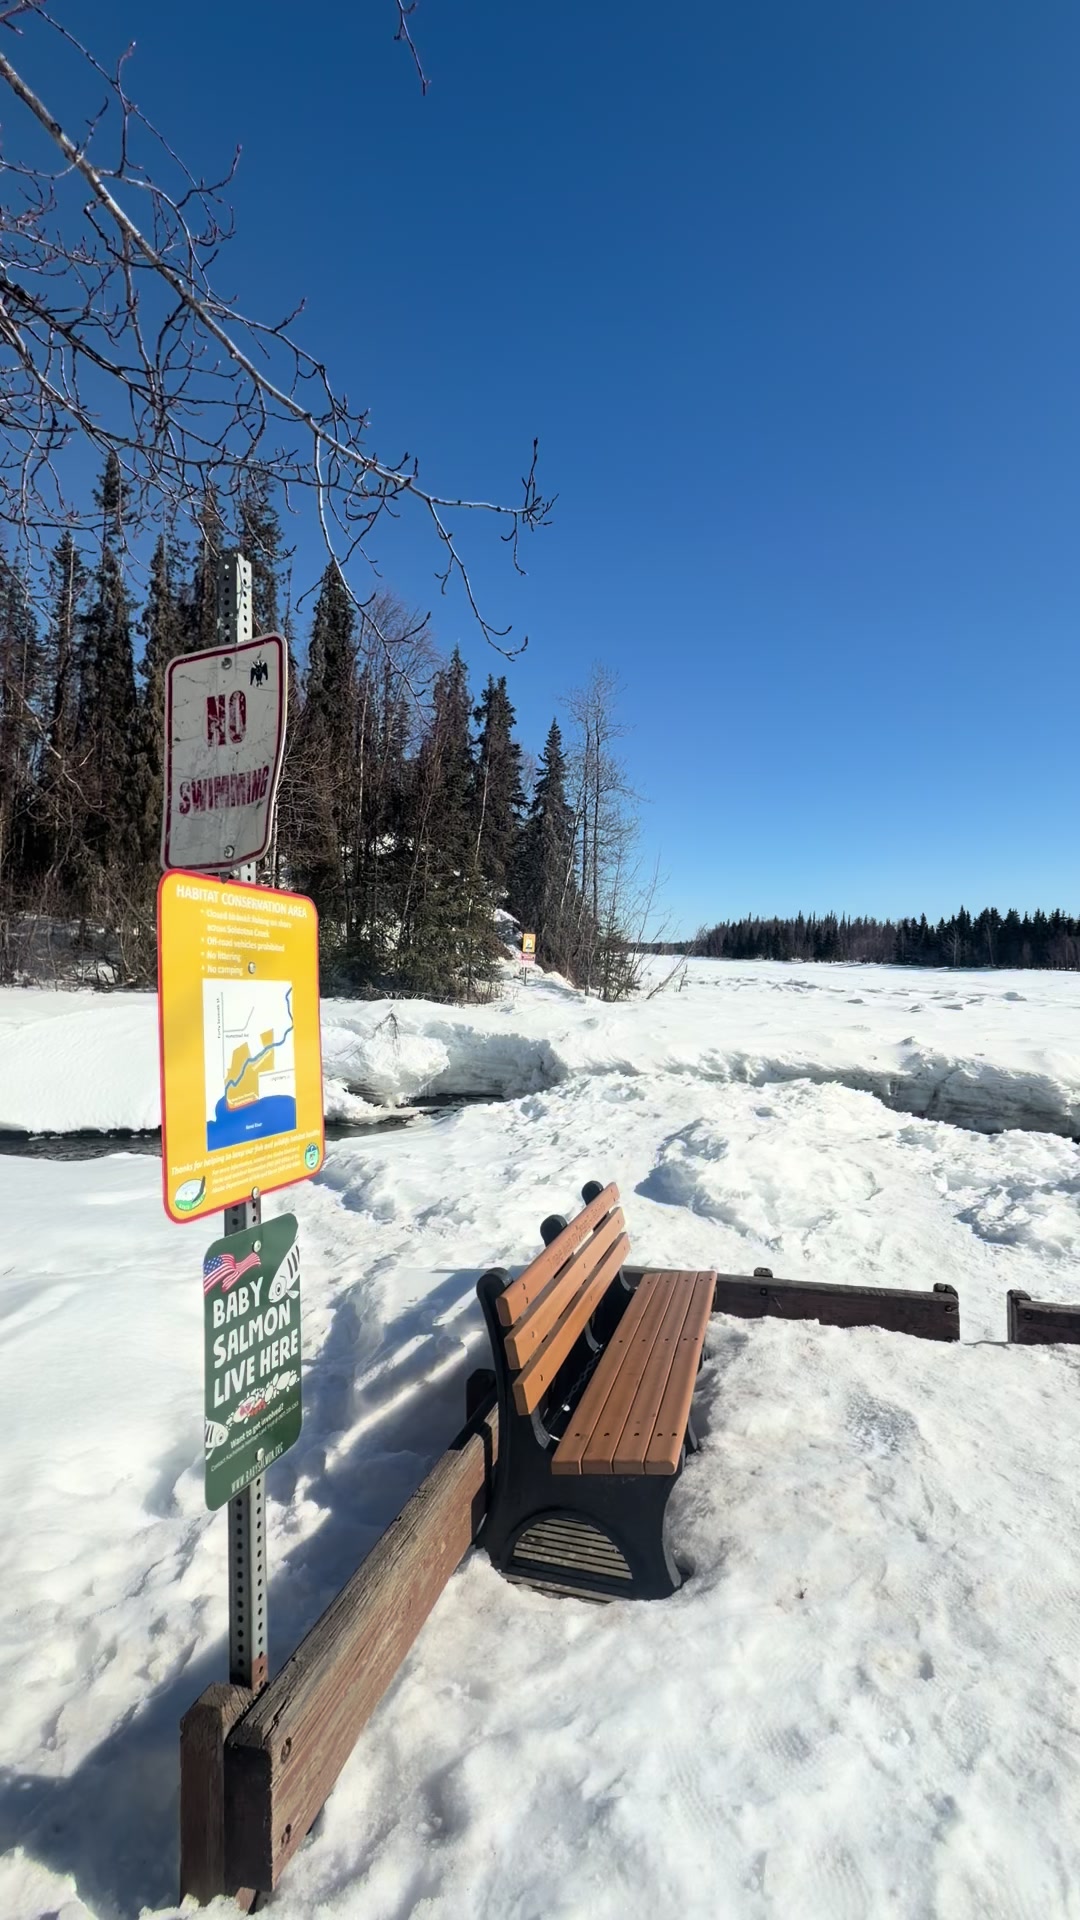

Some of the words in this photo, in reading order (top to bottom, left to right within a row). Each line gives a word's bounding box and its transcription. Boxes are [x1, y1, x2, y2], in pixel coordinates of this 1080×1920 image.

[206, 690, 247, 746] NO
[179, 765, 270, 815] SWIMMING
[176, 884, 219, 903] HABITAT
[221, 892, 287, 914] CONSERVATION
[287, 905, 308, 918] AREA
[207, 951, 216, 959] No
[217, 951, 242, 963] littering
[233, 939, 257, 950] vehicles
[257, 942, 285, 953] prohibited
[207, 965, 217, 973] No
[217, 965, 243, 976] camping
[171, 1163, 193, 1176] Thanks
[193, 1160, 203, 1172] for
[213, 1276, 264, 1329] BABY
[213, 1299, 290, 1369] SALMON
[213, 1355, 255, 1408] LIVE
[260, 1328, 298, 1378] HERE
[230, 1433, 245, 1448] Want
[246, 1429, 252, 1438] to
[252, 1421, 261, 1437] get
[261, 1402, 284, 1426] involved?
